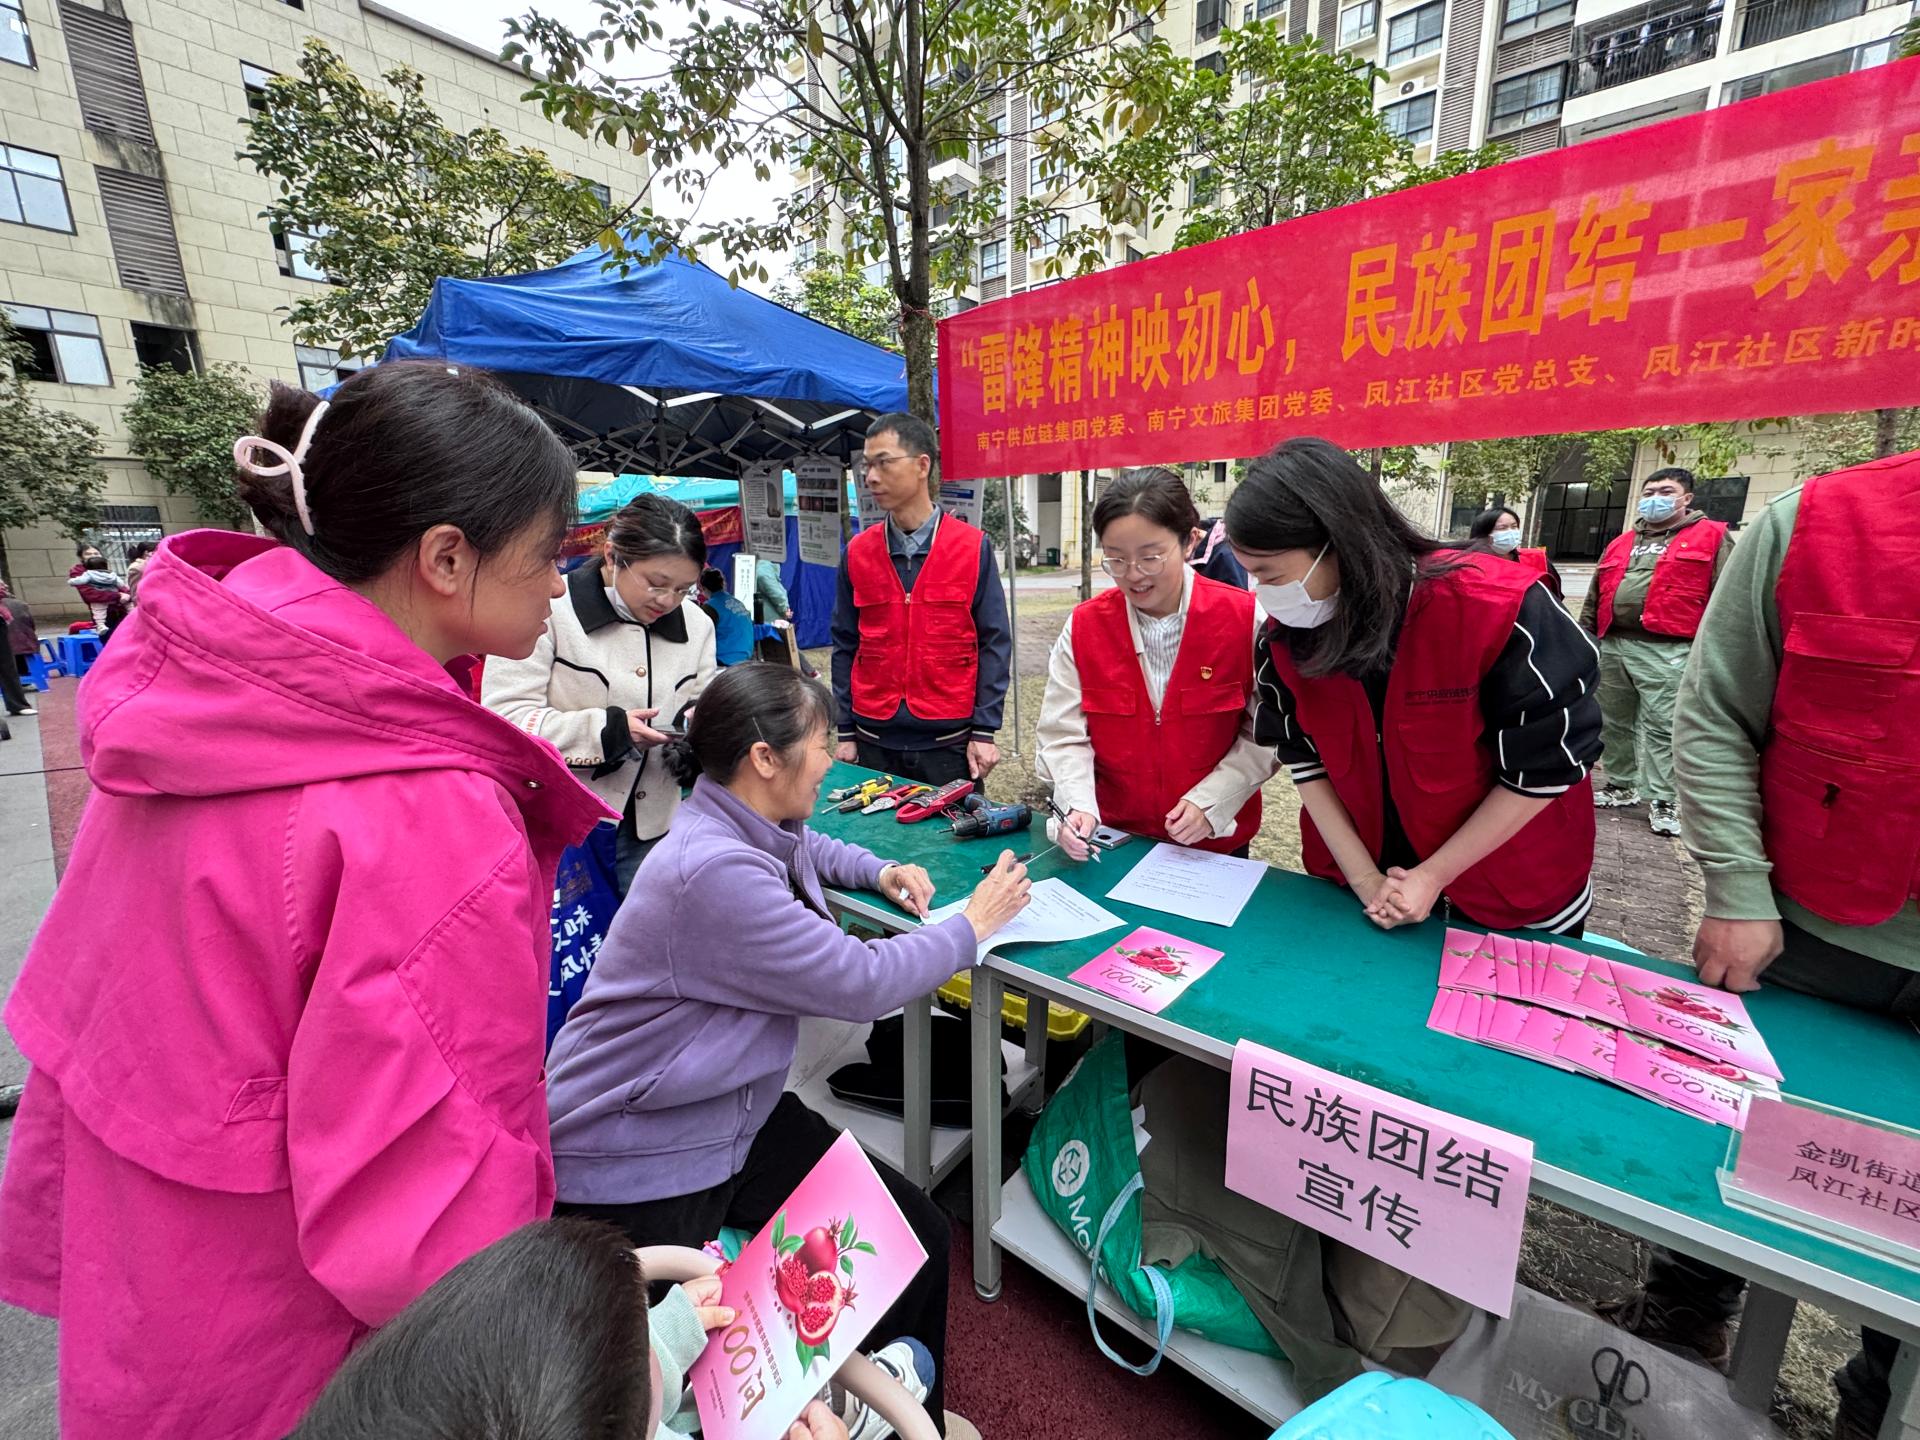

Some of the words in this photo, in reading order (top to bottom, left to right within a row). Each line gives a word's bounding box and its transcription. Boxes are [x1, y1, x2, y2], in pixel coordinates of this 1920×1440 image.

[1246, 1067, 1509, 1208] 民族团结
[1296, 1158, 1421, 1249] 宣传
[1787, 1166, 1920, 1223] 凤江社区
